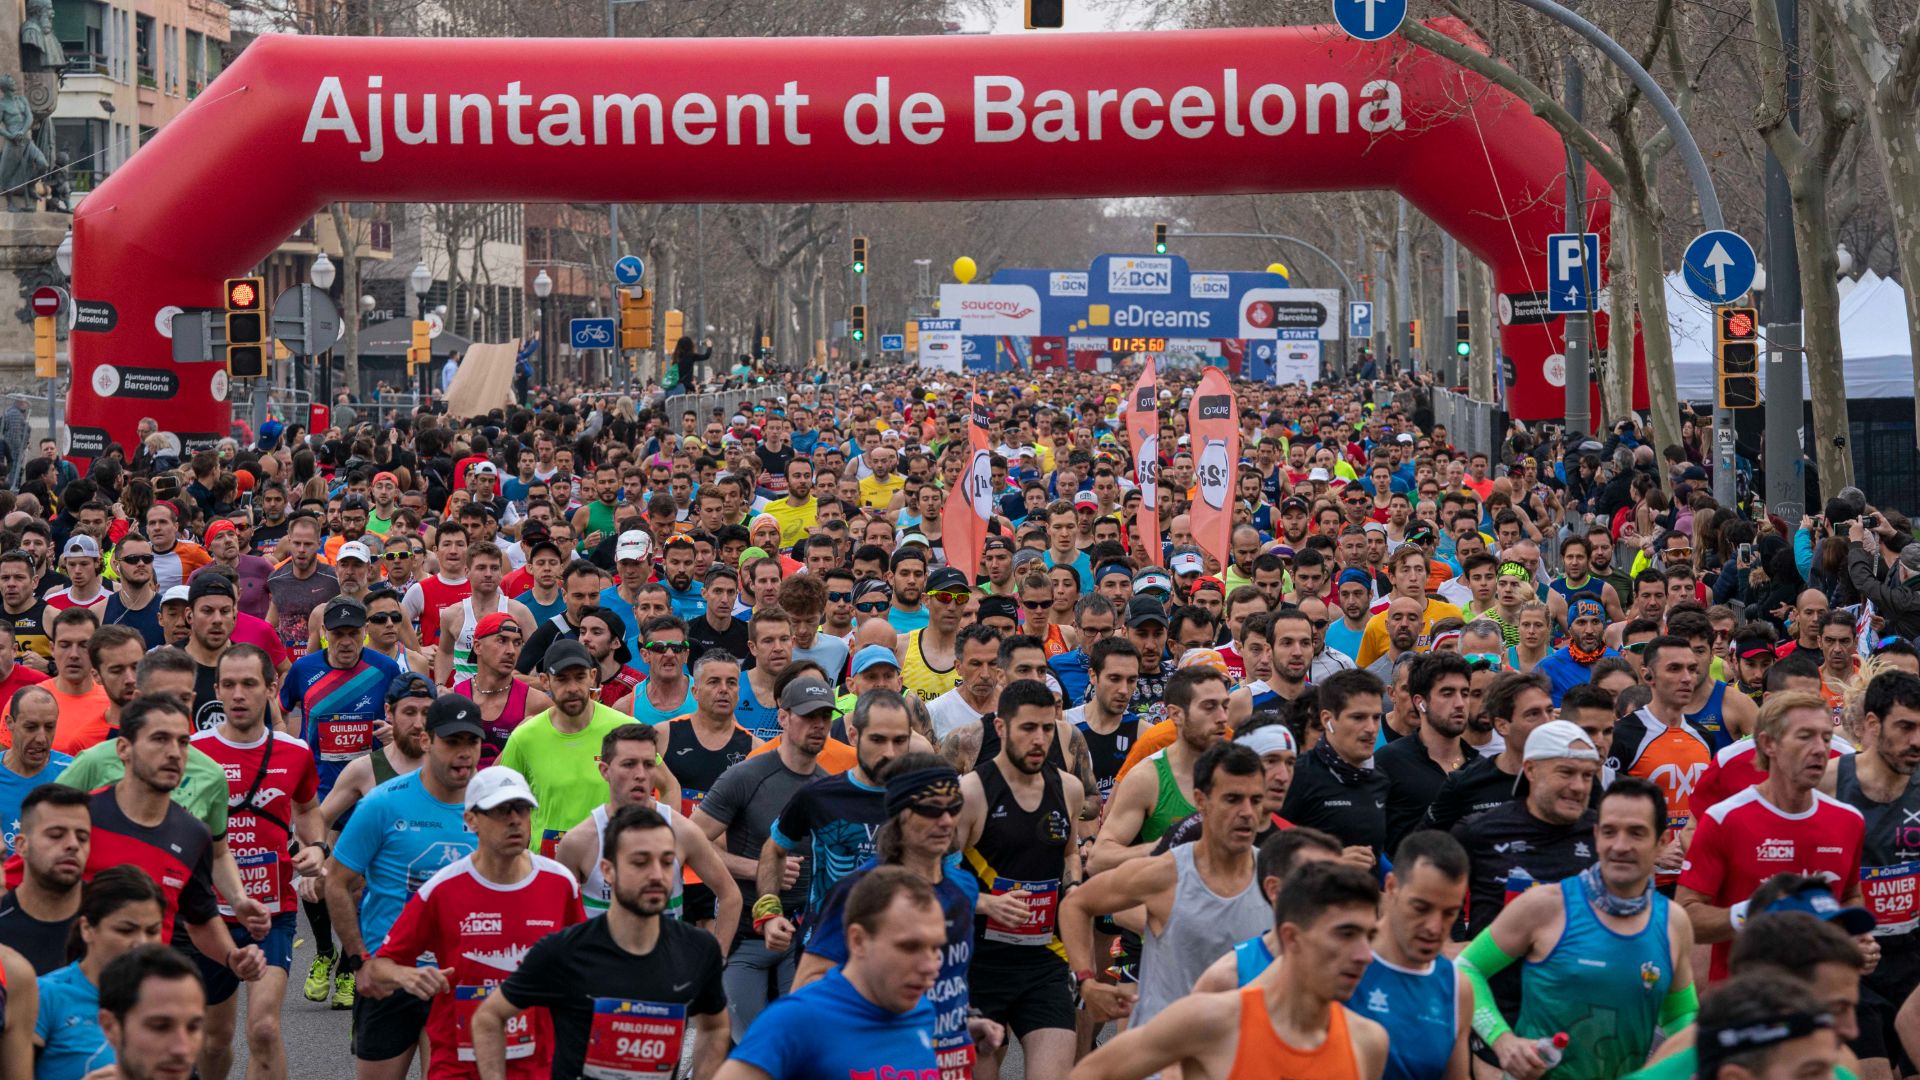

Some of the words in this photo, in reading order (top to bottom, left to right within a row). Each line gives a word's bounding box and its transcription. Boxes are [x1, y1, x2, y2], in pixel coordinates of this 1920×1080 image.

[301, 75, 812, 162] Ajuntament
[843, 76, 945, 145] de
[973, 68, 1407, 143] Barcelona
[1136, 261, 1169, 270] eDreams
[1558, 239, 1590, 281] P
[1130, 271, 1169, 287] BCN
[79, 306, 101, 315] Ajuntament
[961, 300, 1020, 312] saucony
[78, 313, 109, 325] Barcelona
[1114, 305, 1211, 328] eDreams
[1278, 313, 1319, 322] Barcelona
[1353, 304, 1369, 324] P
[922, 321, 955, 330] START
[1282, 330, 1316, 339] START
[1070, 342, 1107, 350] SUUNTO
[124, 373, 161, 382] Ajuntament
[124, 381, 169, 392] Barcelona
[73, 432, 95, 441] Ajuntament
[72, 440, 103, 450] Barcelona
[329, 723, 369, 733] GUILBAUD
[334, 734, 365, 746] 6174
[227, 816, 256, 828] RUN
[227, 832, 256, 843] FOR
[1768, 846, 1795, 858] BCN
[239, 866, 268, 881] AVID
[1879, 866, 1910, 877] eDreams
[1021, 883, 1049, 891] eDreams
[1868, 877, 1917, 897] JAVIER
[1874, 893, 1914, 913] 5429
[472, 919, 502, 932] BCN
[948, 941, 970, 966] NO
[632, 1003, 670, 1015] eDreams
[611, 1021, 642, 1034] PABLO
[643, 1023, 677, 1036] FABIÁN
[615, 1037, 666, 1059] 9460
